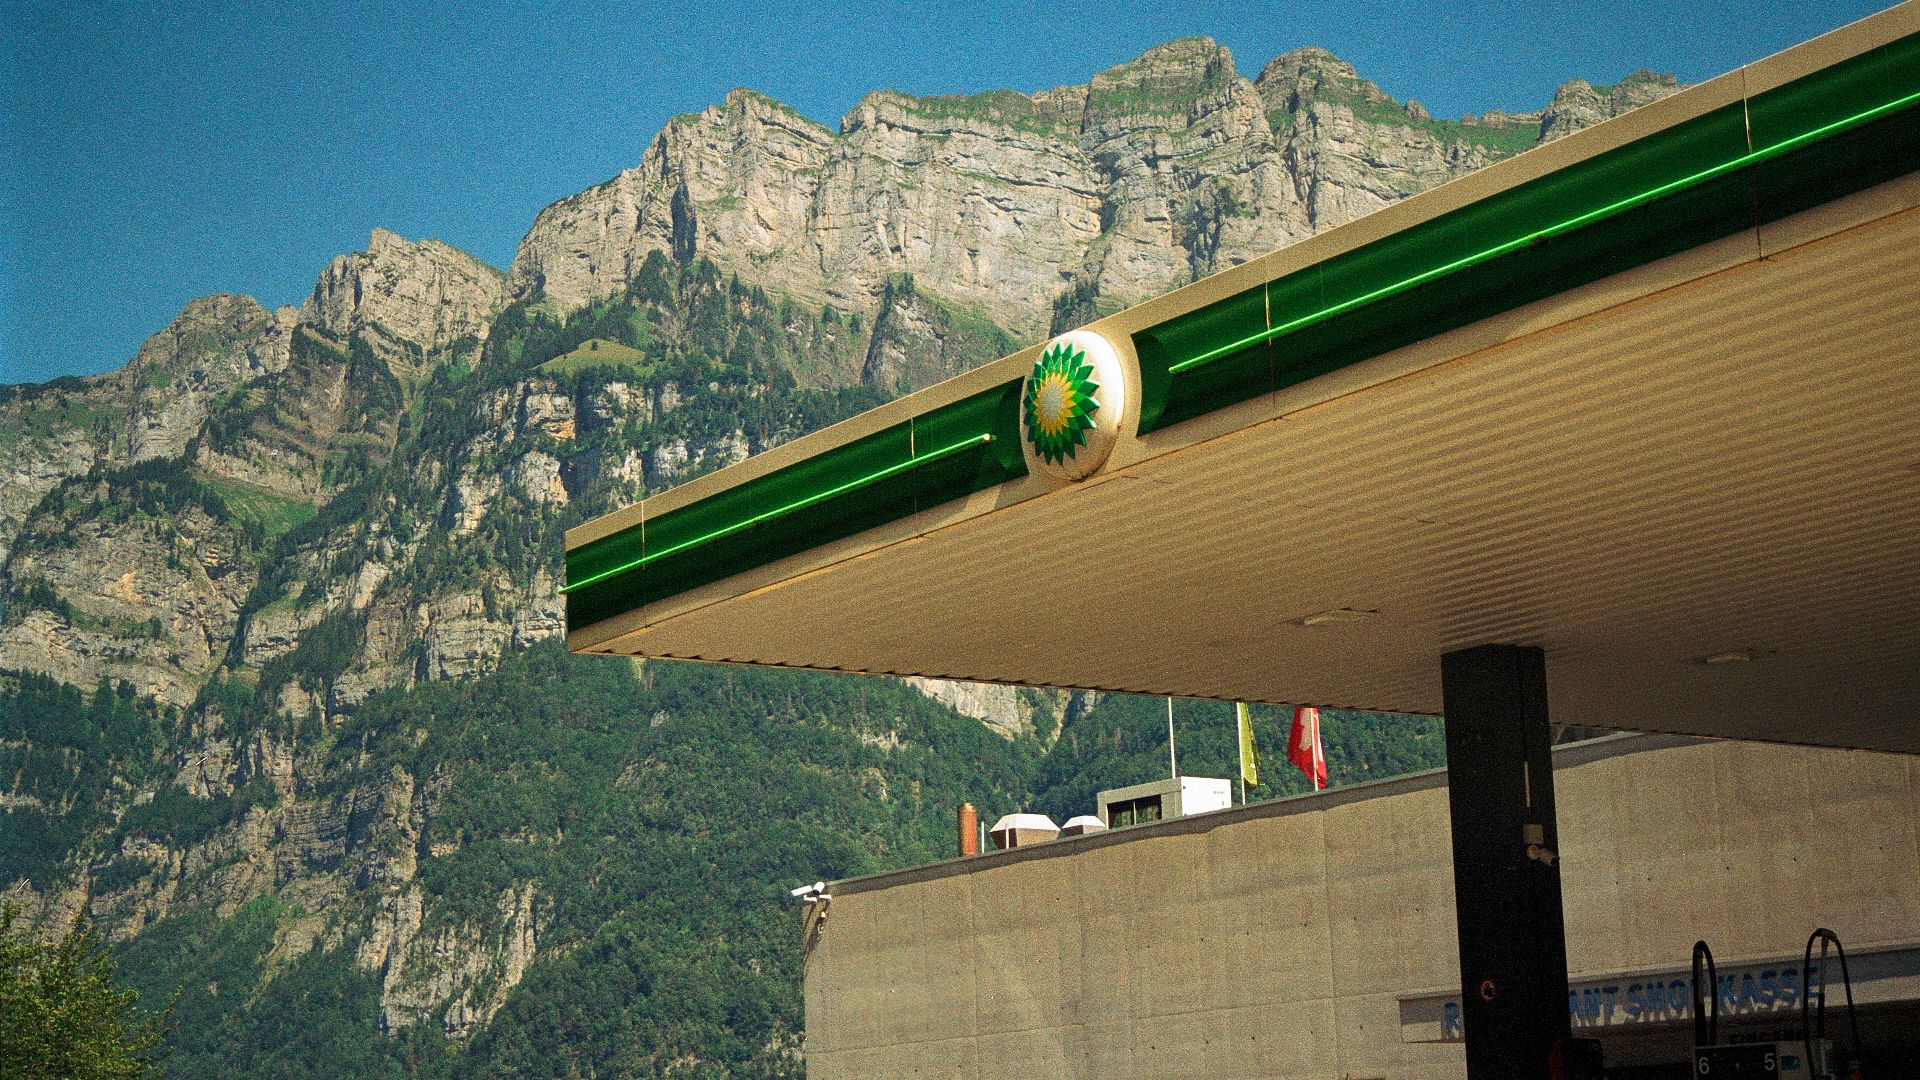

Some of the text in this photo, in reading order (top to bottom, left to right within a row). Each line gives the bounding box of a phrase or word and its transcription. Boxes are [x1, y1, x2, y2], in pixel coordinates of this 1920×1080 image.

[1716, 966, 1821, 1006] KASSE
[1699, 1056, 1710, 1075] 6
[1764, 1053, 1775, 1071] 5
